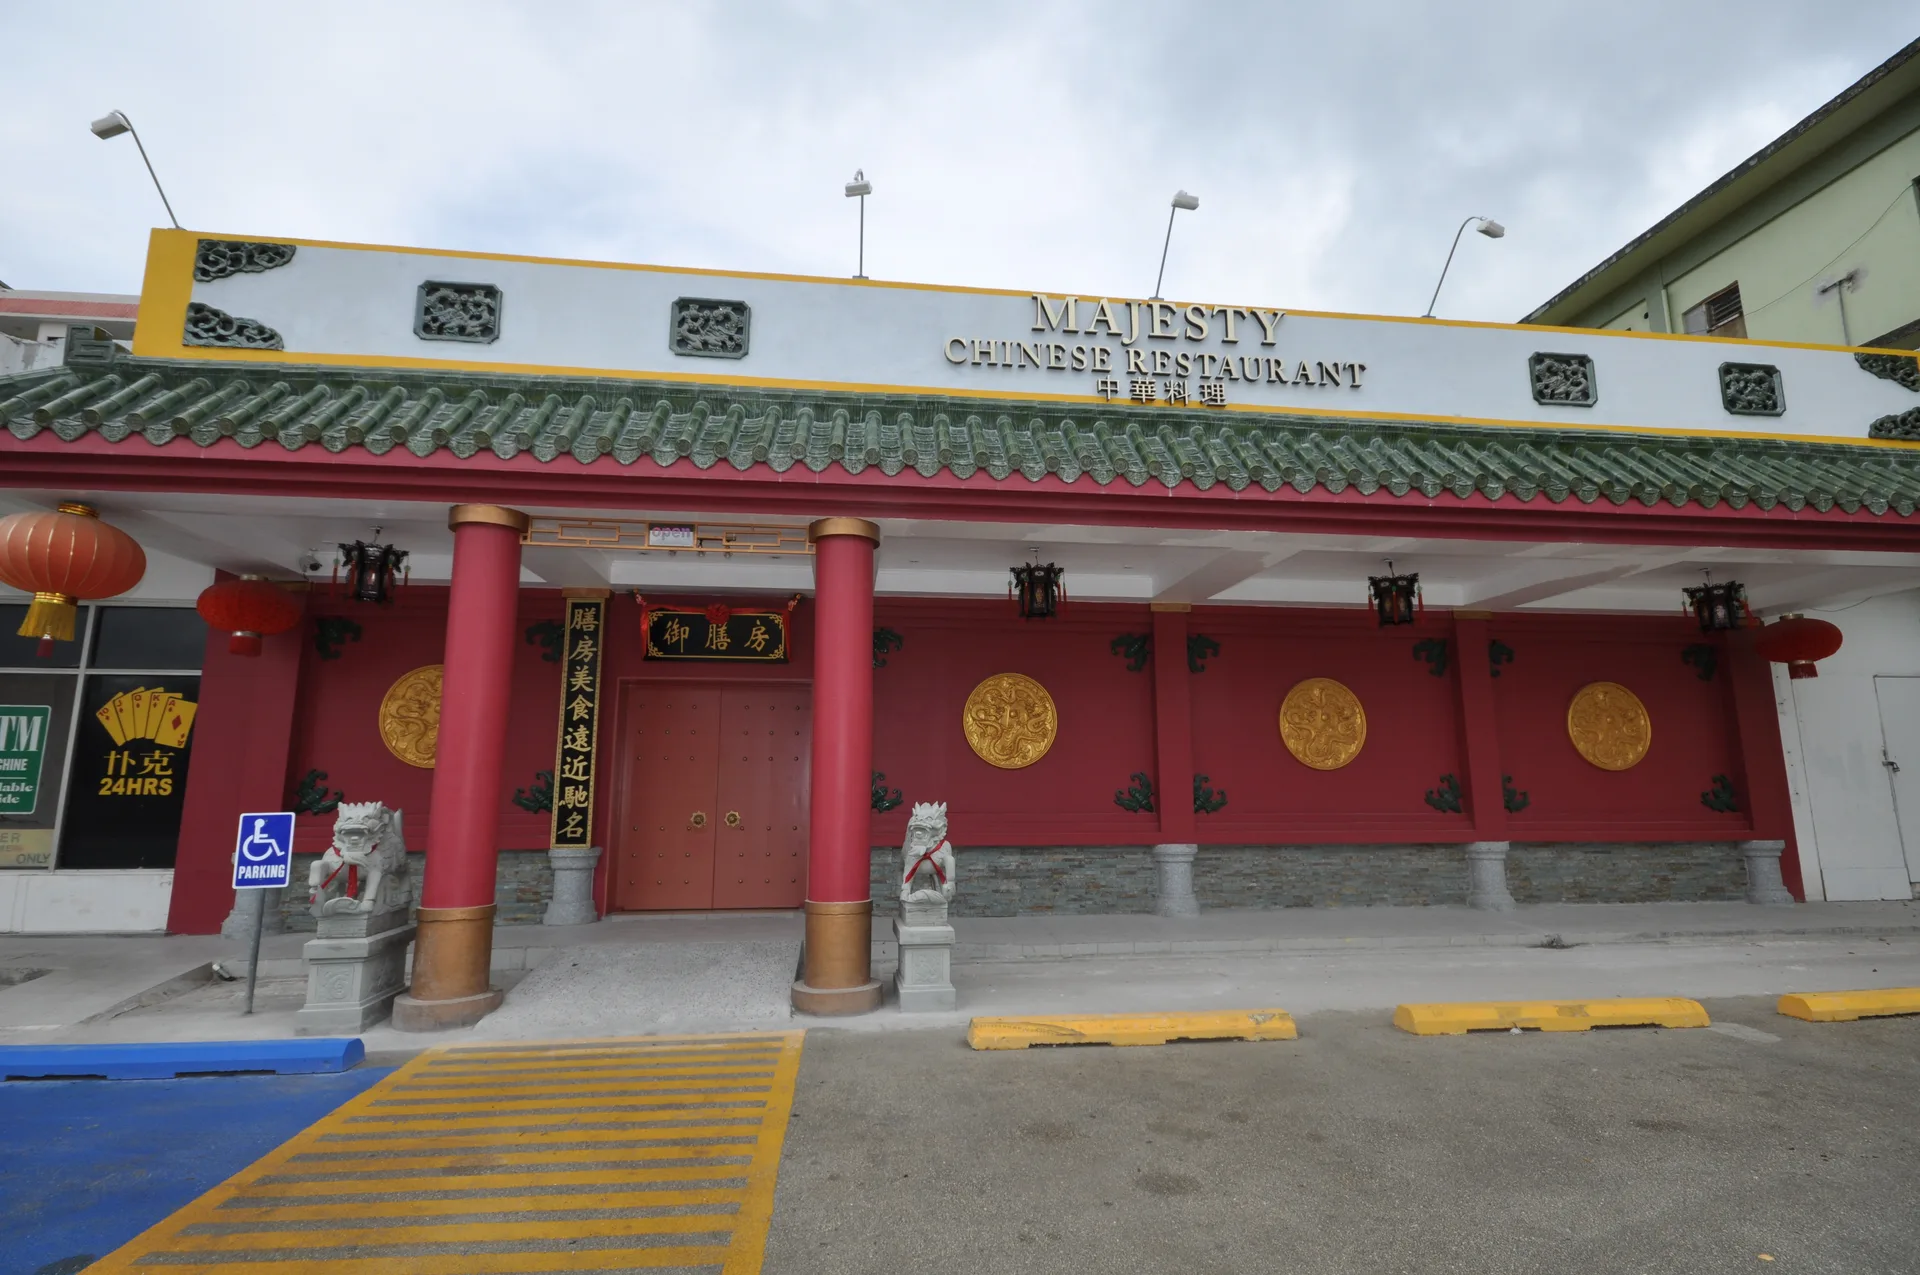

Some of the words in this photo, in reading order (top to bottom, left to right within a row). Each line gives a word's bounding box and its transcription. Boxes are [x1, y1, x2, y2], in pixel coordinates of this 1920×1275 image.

[1032, 294, 1286, 346] MAJESTY
[944, 337, 1113, 373] CHINESE
[1125, 347, 1366, 388] RESTAURANT
[1097, 375, 1227, 408] 中華料理
[651, 526, 691, 541] open
[663, 618, 770, 653] 御膳房
[558, 607, 600, 839] 膳房美食遠近馳名
[98, 778, 173, 796] 24HRS
[16, 853, 51, 865] ONLY
[238, 864, 286, 880] PARKING
